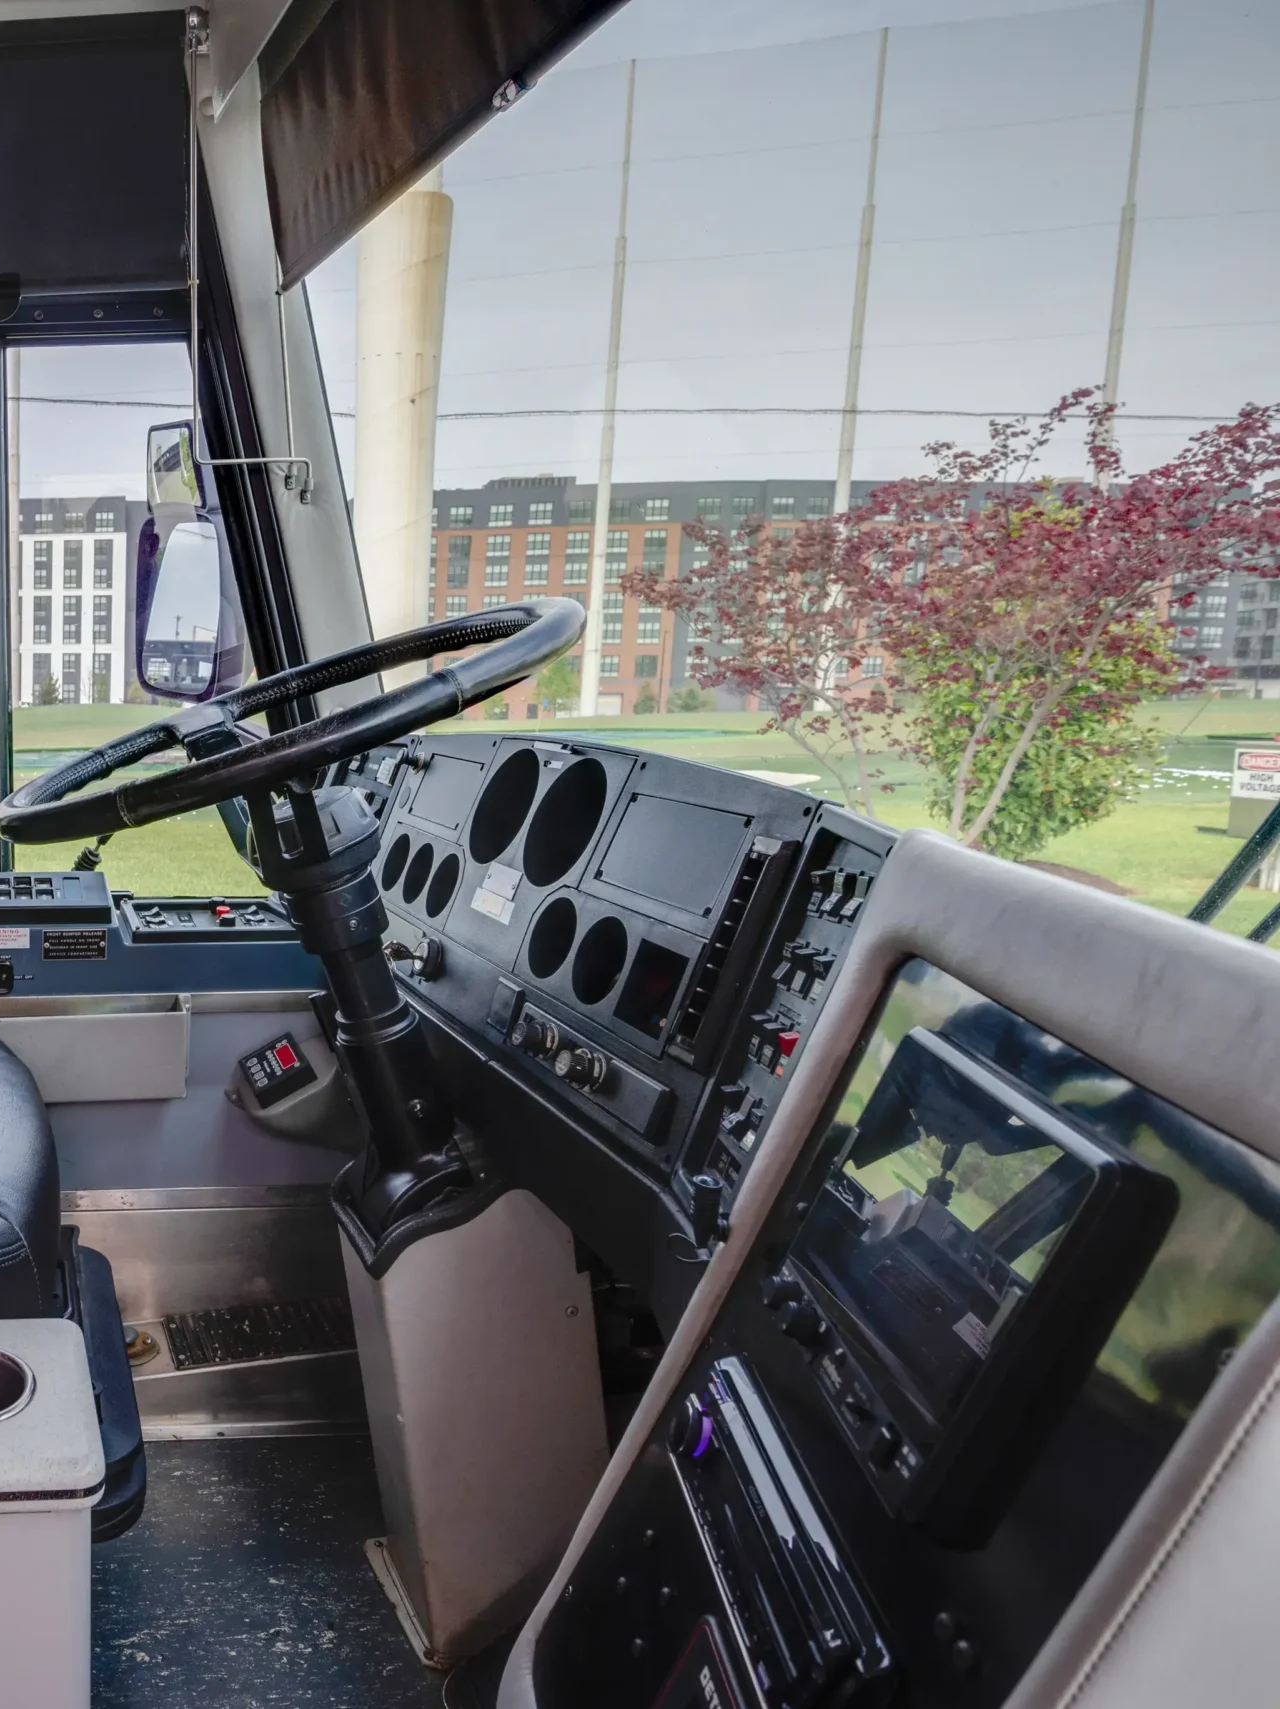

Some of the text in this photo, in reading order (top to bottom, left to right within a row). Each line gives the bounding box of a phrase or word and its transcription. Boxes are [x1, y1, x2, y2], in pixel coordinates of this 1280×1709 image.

[1249, 773, 1274, 782] HIGH
[1239, 782, 1280, 793] VOLTAGE
[700, 1665, 724, 1709] DET
